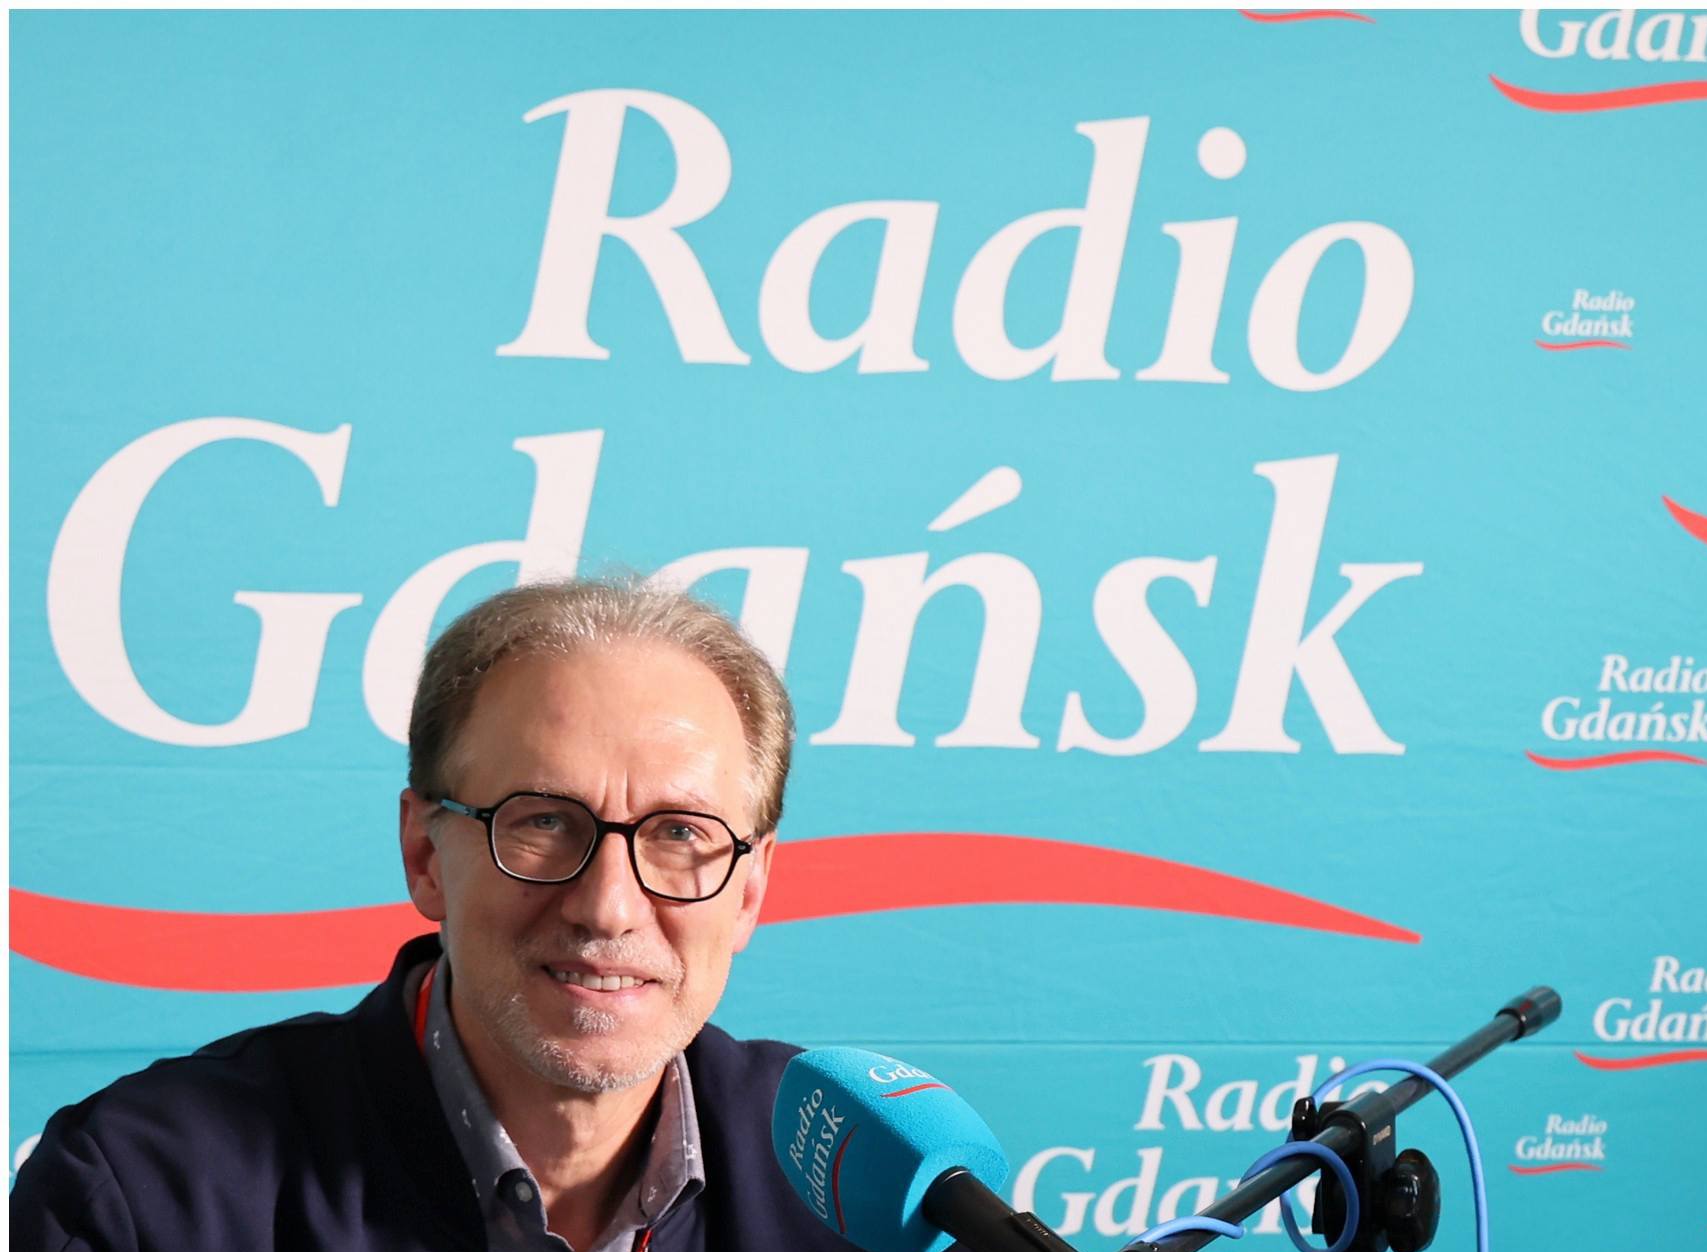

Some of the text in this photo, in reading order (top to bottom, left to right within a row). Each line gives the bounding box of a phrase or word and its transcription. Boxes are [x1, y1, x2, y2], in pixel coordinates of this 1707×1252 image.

[495, 88, 1415, 391] Radio
[1541, 310, 1635, 339] Gdańsk
[1571, 288, 1635, 311] Radio
[1134, 1053, 1392, 1132] Rad
[788, 1089, 823, 1171] Radio
[1514, 1136, 1607, 1162] Gdańsk
[1545, 1113, 1608, 1137] Radio
[806, 1105, 846, 1219] Gdańsk
